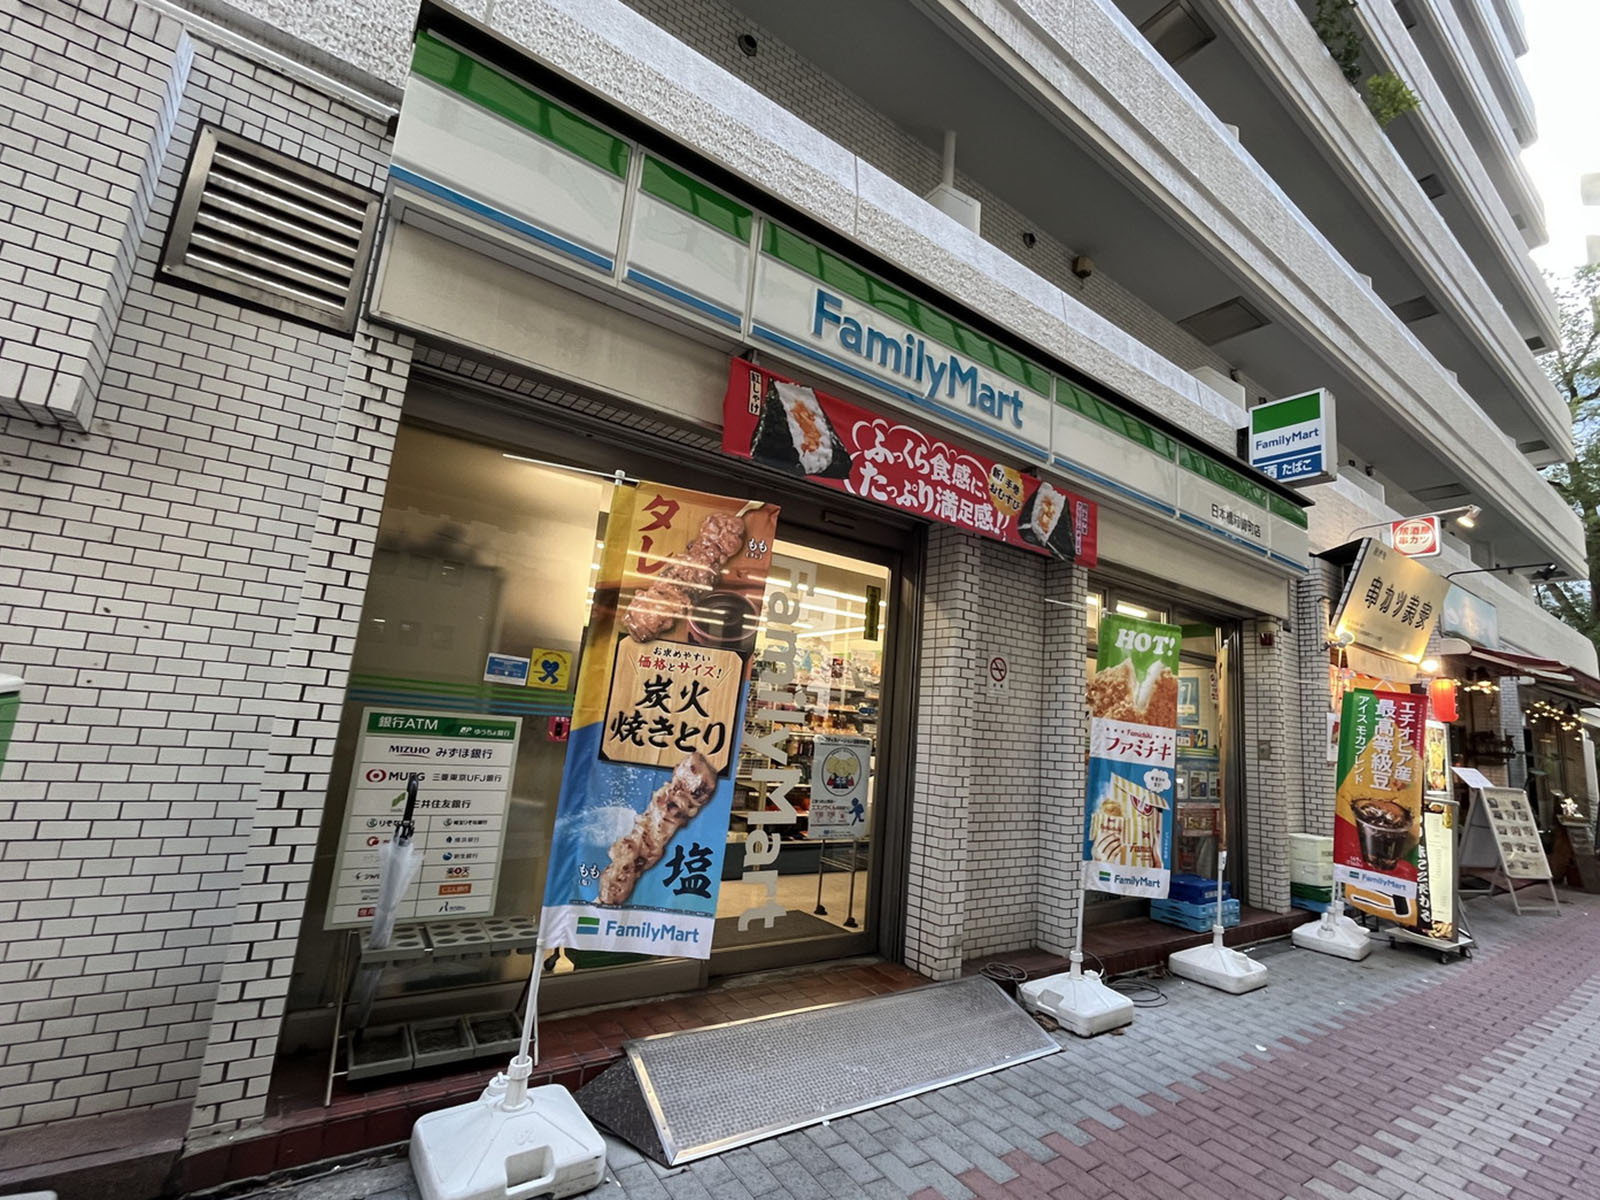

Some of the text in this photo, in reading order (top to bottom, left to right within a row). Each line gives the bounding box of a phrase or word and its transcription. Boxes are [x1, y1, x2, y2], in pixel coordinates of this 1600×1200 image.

[811, 288, 1023, 428] FamilyMart
[750, 371, 761, 414] 紅しゃけ
[1256, 428, 1319, 450] FamilyMart
[865, 427, 987, 499] ふっくら食感に、
[1282, 459, 1312, 476] たばこ
[990, 483, 1020, 510] おむすび
[637, 494, 680, 574] タレ
[749, 538, 768, 553] もも
[1115, 628, 1176, 656] HOT!
[653, 647, 711, 661] お求めやすい
[638, 655, 722, 679] 価格とサイズ!
[635, 674, 710, 718] 炭火
[377, 715, 439, 731] 銀行ATM
[474, 728, 511, 737] ゆうちょ銀行
[609, 710, 726, 755] 焼きとり
[388, 745, 493, 759] MIZUHO みずほ銀行
[1105, 736, 1172, 761] ファミチキ
[1370, 699, 1397, 791] 最高等級豆
[1394, 701, 1415, 782] エチオピア産
[432, 773, 502, 783] 三菱東京UFJ銀行
[413, 799, 471, 809] 三井住友銀行
[579, 863, 600, 879] もも
[662, 842, 714, 899] 塩
[1114, 874, 1161, 888] FamilyMart
[1361, 873, 1407, 892] FamilyMart
[605, 920, 699, 943] FamilyMart
